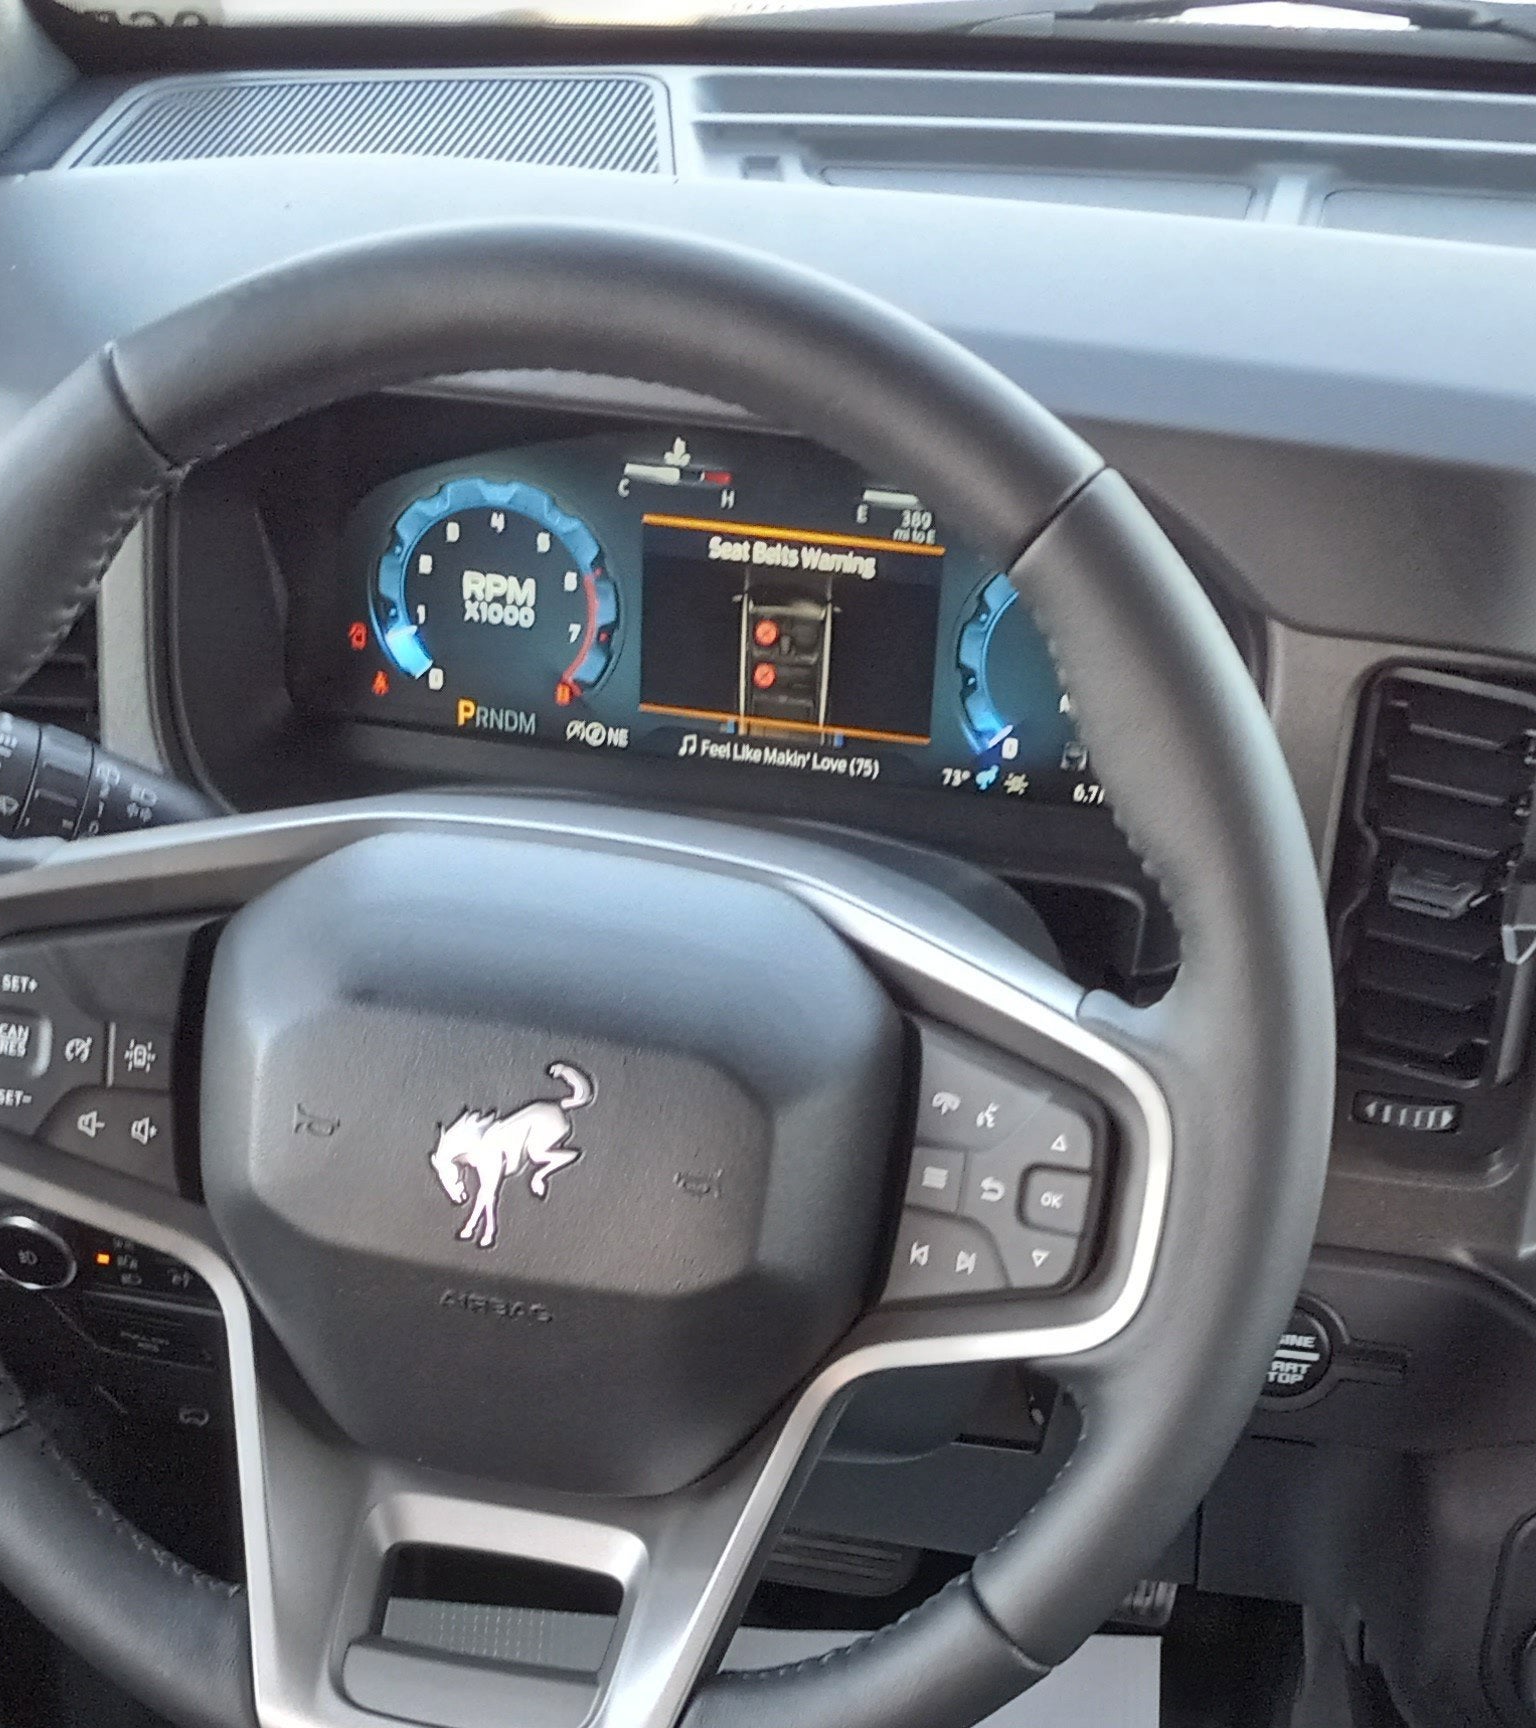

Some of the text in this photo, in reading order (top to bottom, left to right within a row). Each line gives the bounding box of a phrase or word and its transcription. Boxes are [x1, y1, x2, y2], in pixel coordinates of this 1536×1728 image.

[721, 489, 735, 509] H
[491, 512, 505, 533] 4
[709, 535, 876, 580] Seat Belts Warning
[462, 570, 536, 607] RPM
[417, 604, 426, 624] 1
[569, 623, 581, 643] 7
[607, 729, 629, 747] NE
[700, 739, 880, 780] Feel Like Makin' Love (75)
[1040, 1191, 1064, 1209] OK
[1267, 1372, 1304, 1384] TOP
